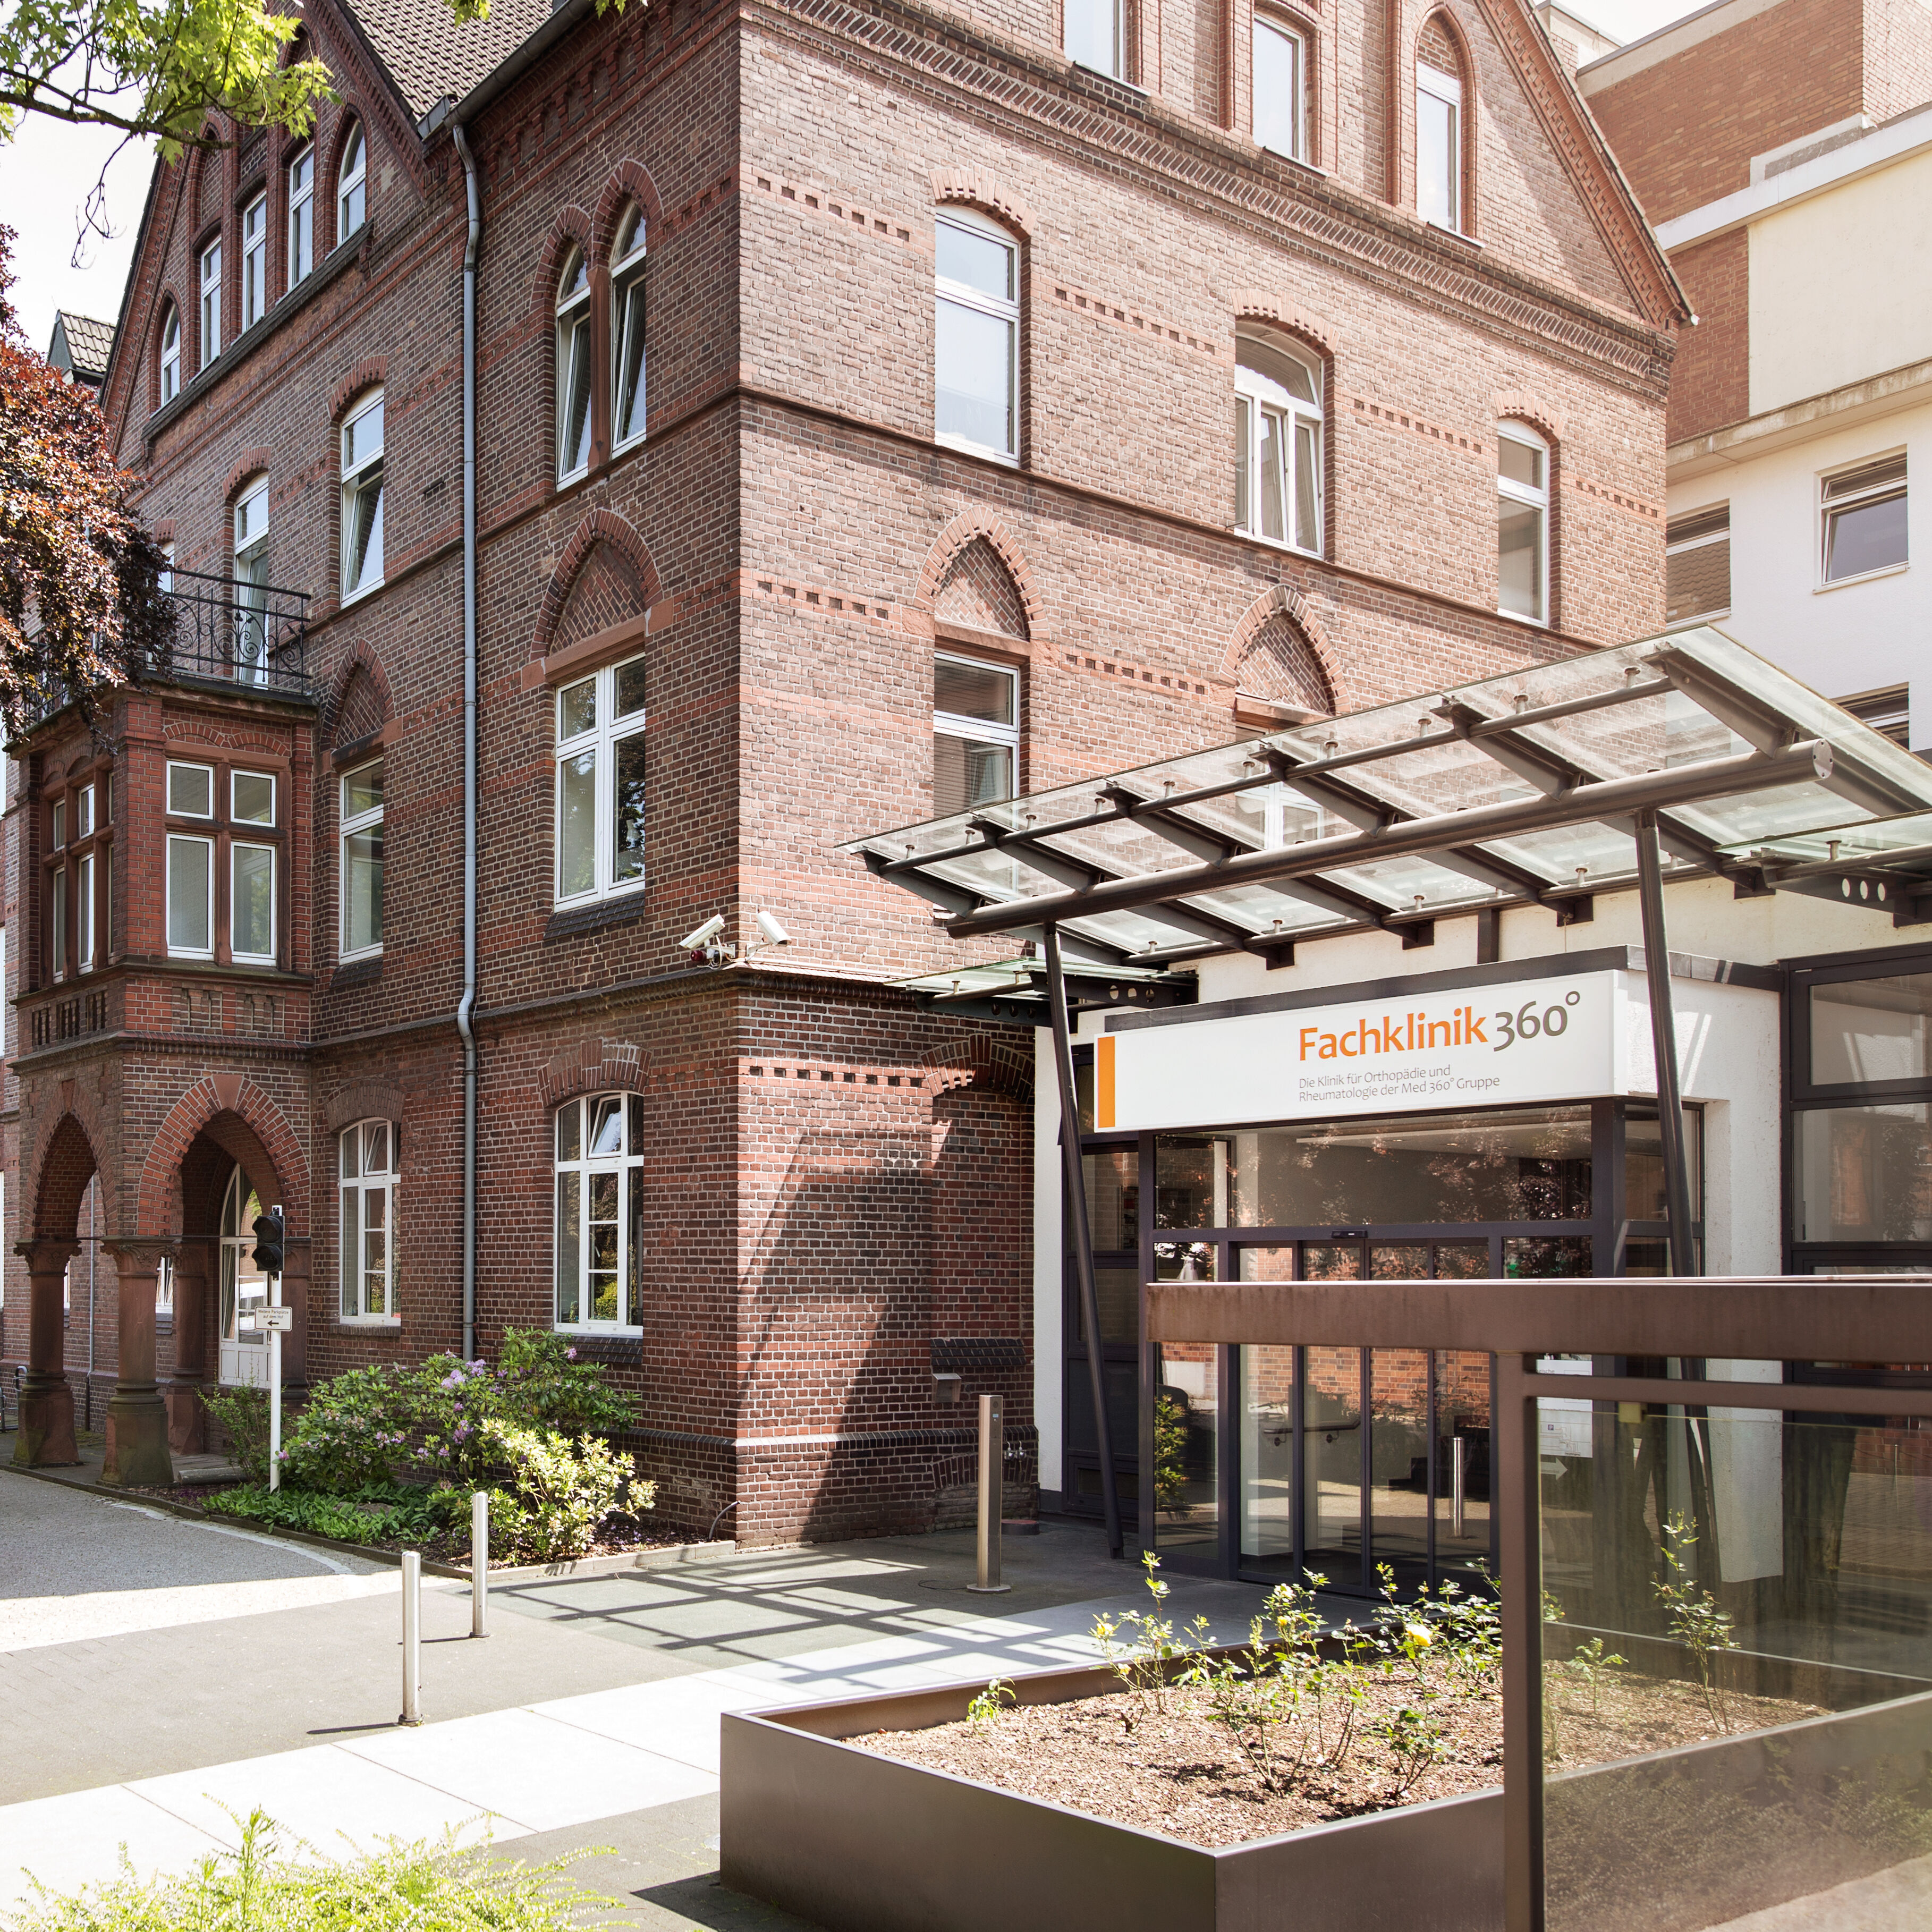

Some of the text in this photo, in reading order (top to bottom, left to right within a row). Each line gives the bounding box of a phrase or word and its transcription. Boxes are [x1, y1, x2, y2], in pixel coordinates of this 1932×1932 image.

[1299, 1064, 1451, 1089] Die Klinik für Orthopädie und
[1299, 1077, 1500, 1101] Rheumatologie der Med 360° Gruppe
